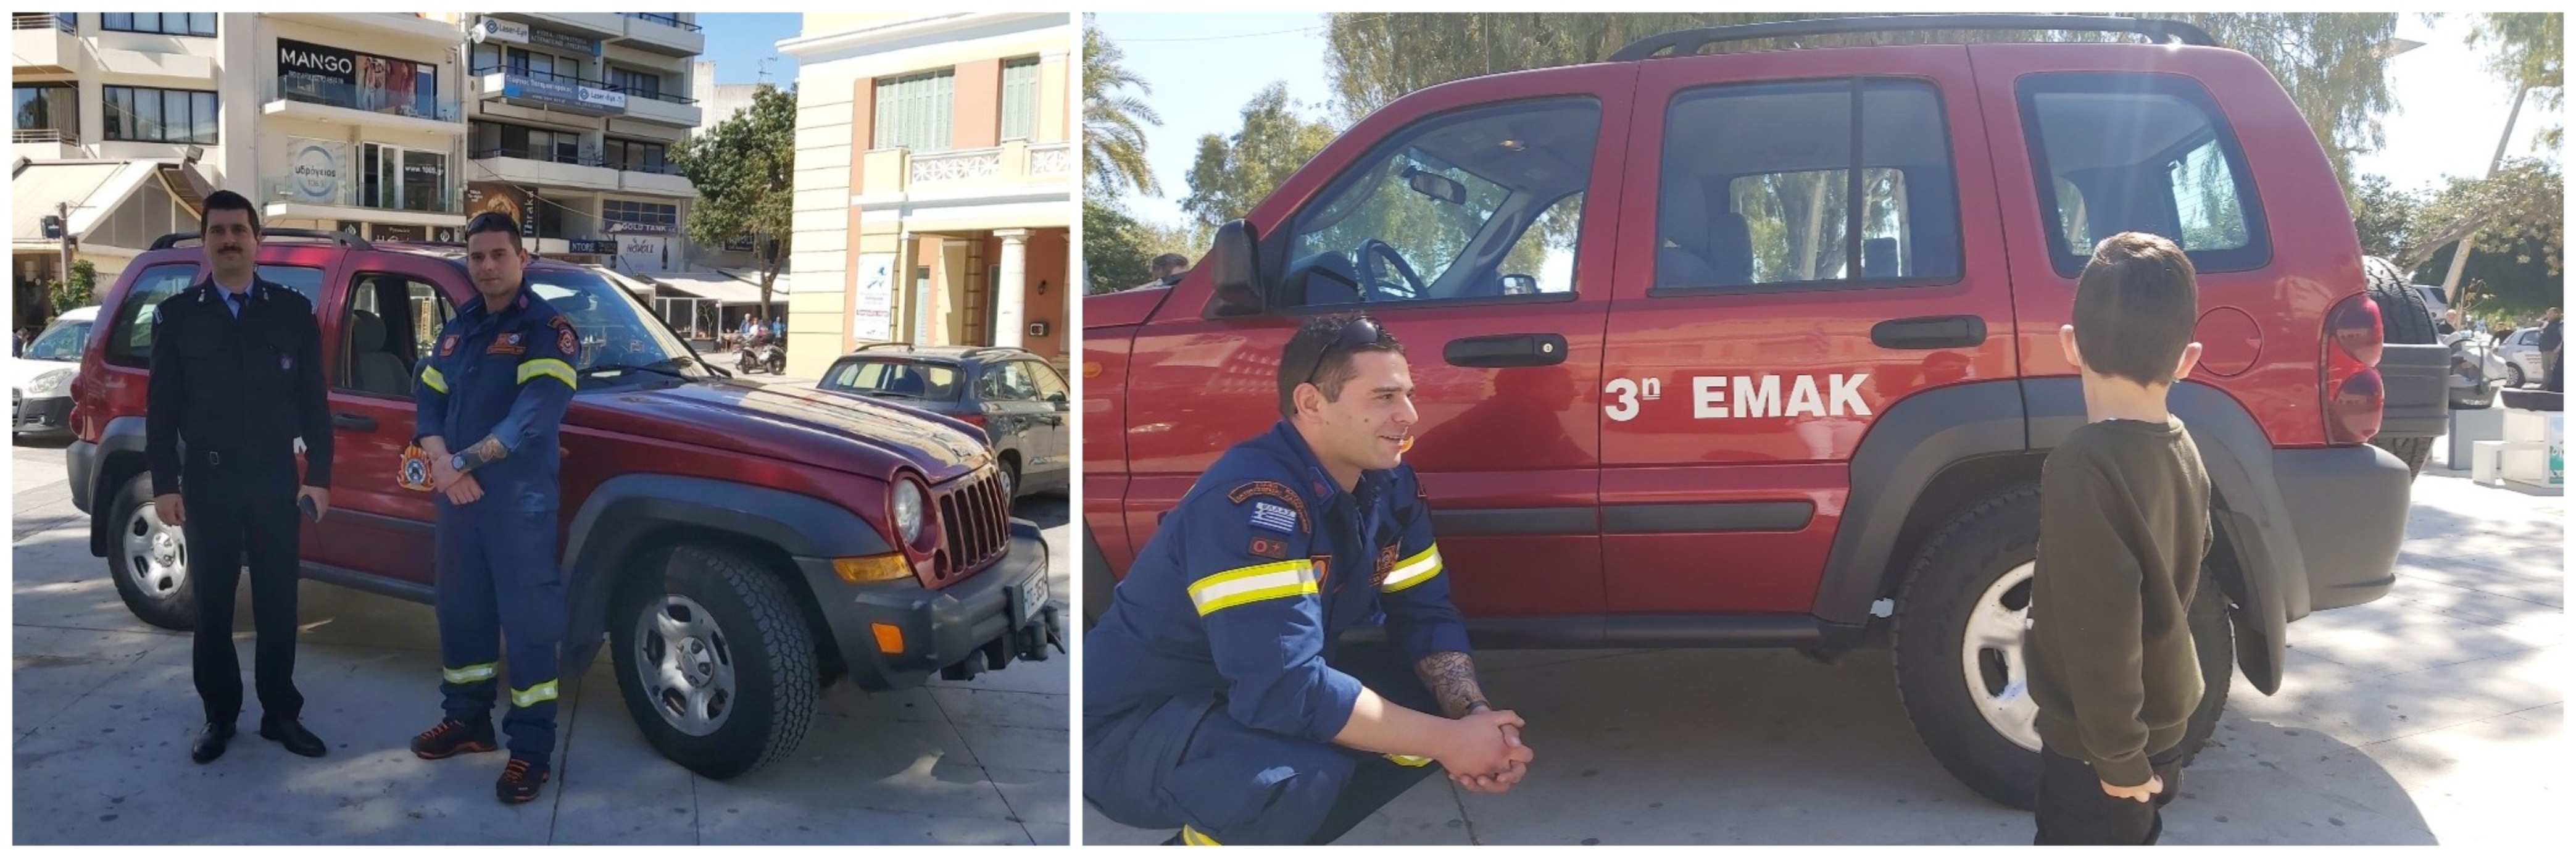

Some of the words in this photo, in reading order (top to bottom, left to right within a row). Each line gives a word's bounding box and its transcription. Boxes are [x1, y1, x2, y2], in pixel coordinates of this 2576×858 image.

[281, 48, 352, 73] MANGO
[295, 165, 336, 178] υδρόγειος
[523, 191, 534, 235] Thraka
[622, 222, 643, 231] GOLD
